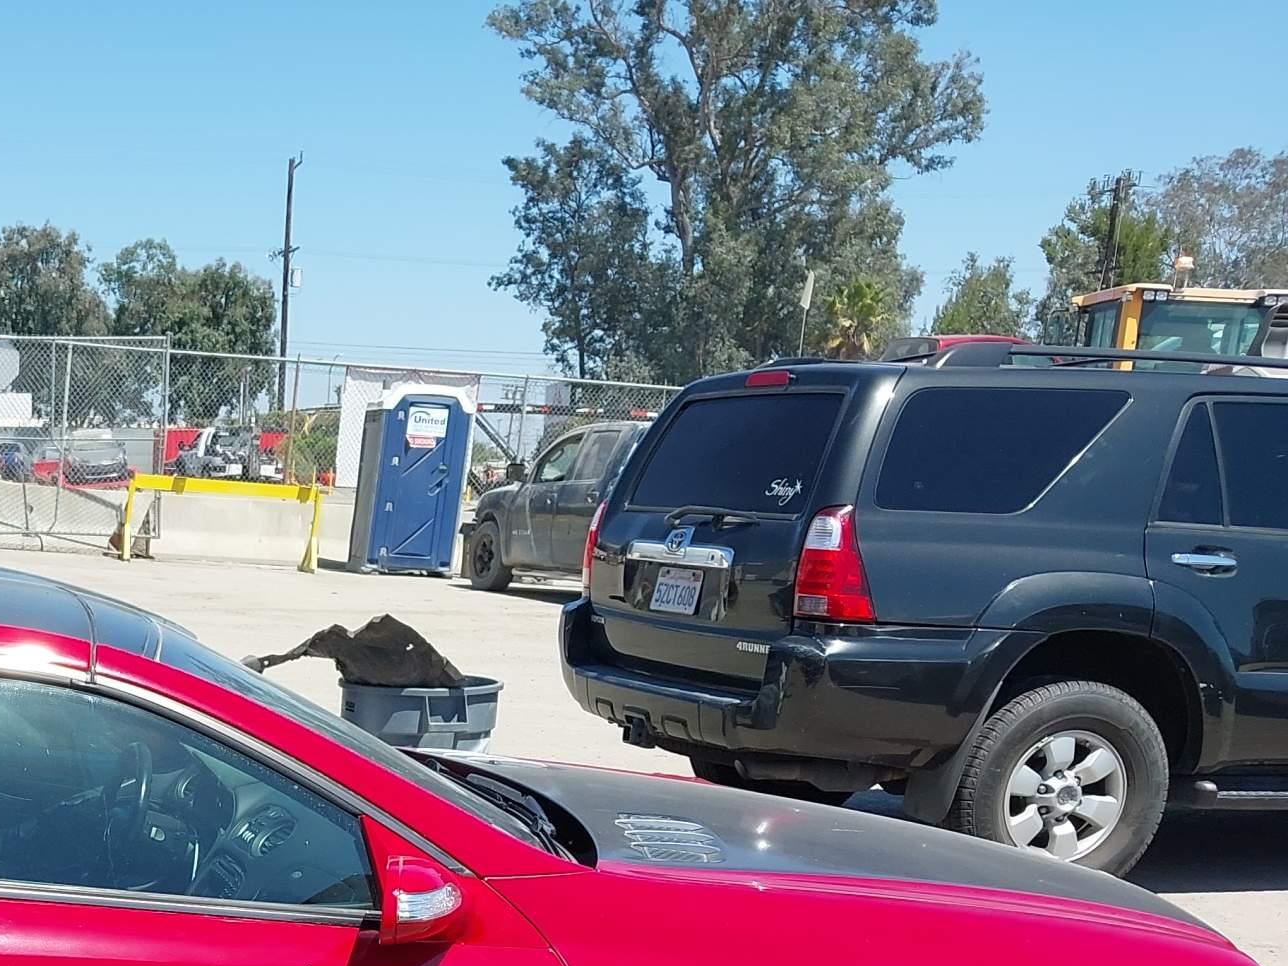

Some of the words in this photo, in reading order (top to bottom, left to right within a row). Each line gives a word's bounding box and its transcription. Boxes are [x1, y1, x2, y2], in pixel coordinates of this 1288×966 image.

[414, 415, 447, 426] United
[765, 478, 797, 506] Shiny
[654, 582, 697, 608] 5ZCT608
[736, 641, 771, 654] 4RUNNE
